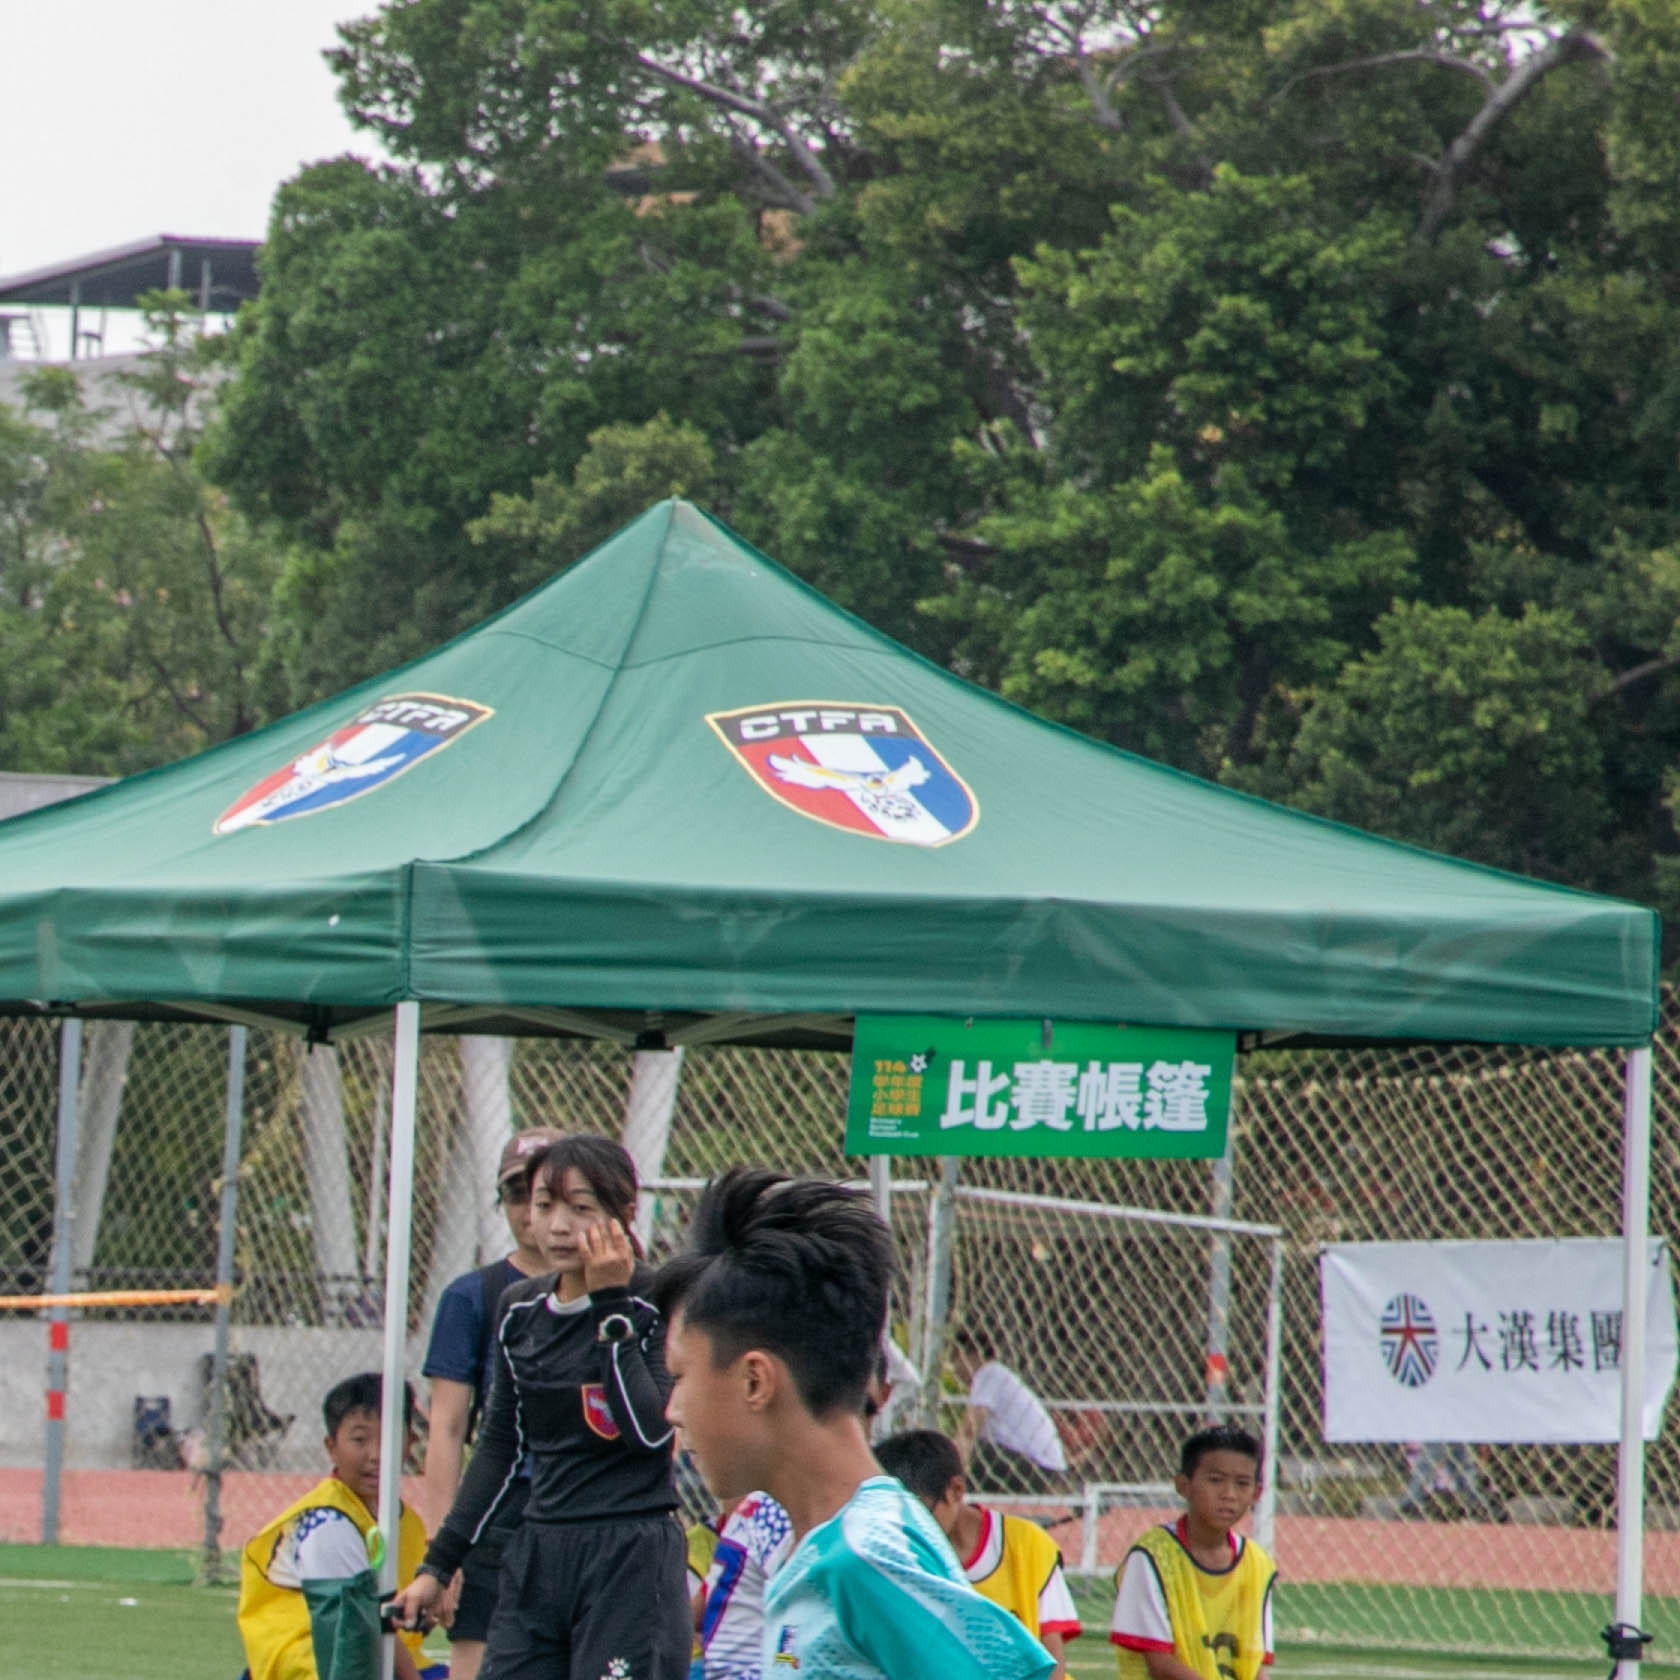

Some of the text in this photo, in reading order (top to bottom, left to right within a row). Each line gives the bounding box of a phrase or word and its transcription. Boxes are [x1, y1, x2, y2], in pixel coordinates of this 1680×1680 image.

[740, 711, 898, 740] CTFA
[939, 1060, 1211, 1132] 比賽帳篷
[1452, 1311, 1623, 1373] 大漢集團
[702, 1538, 747, 1650] 7
